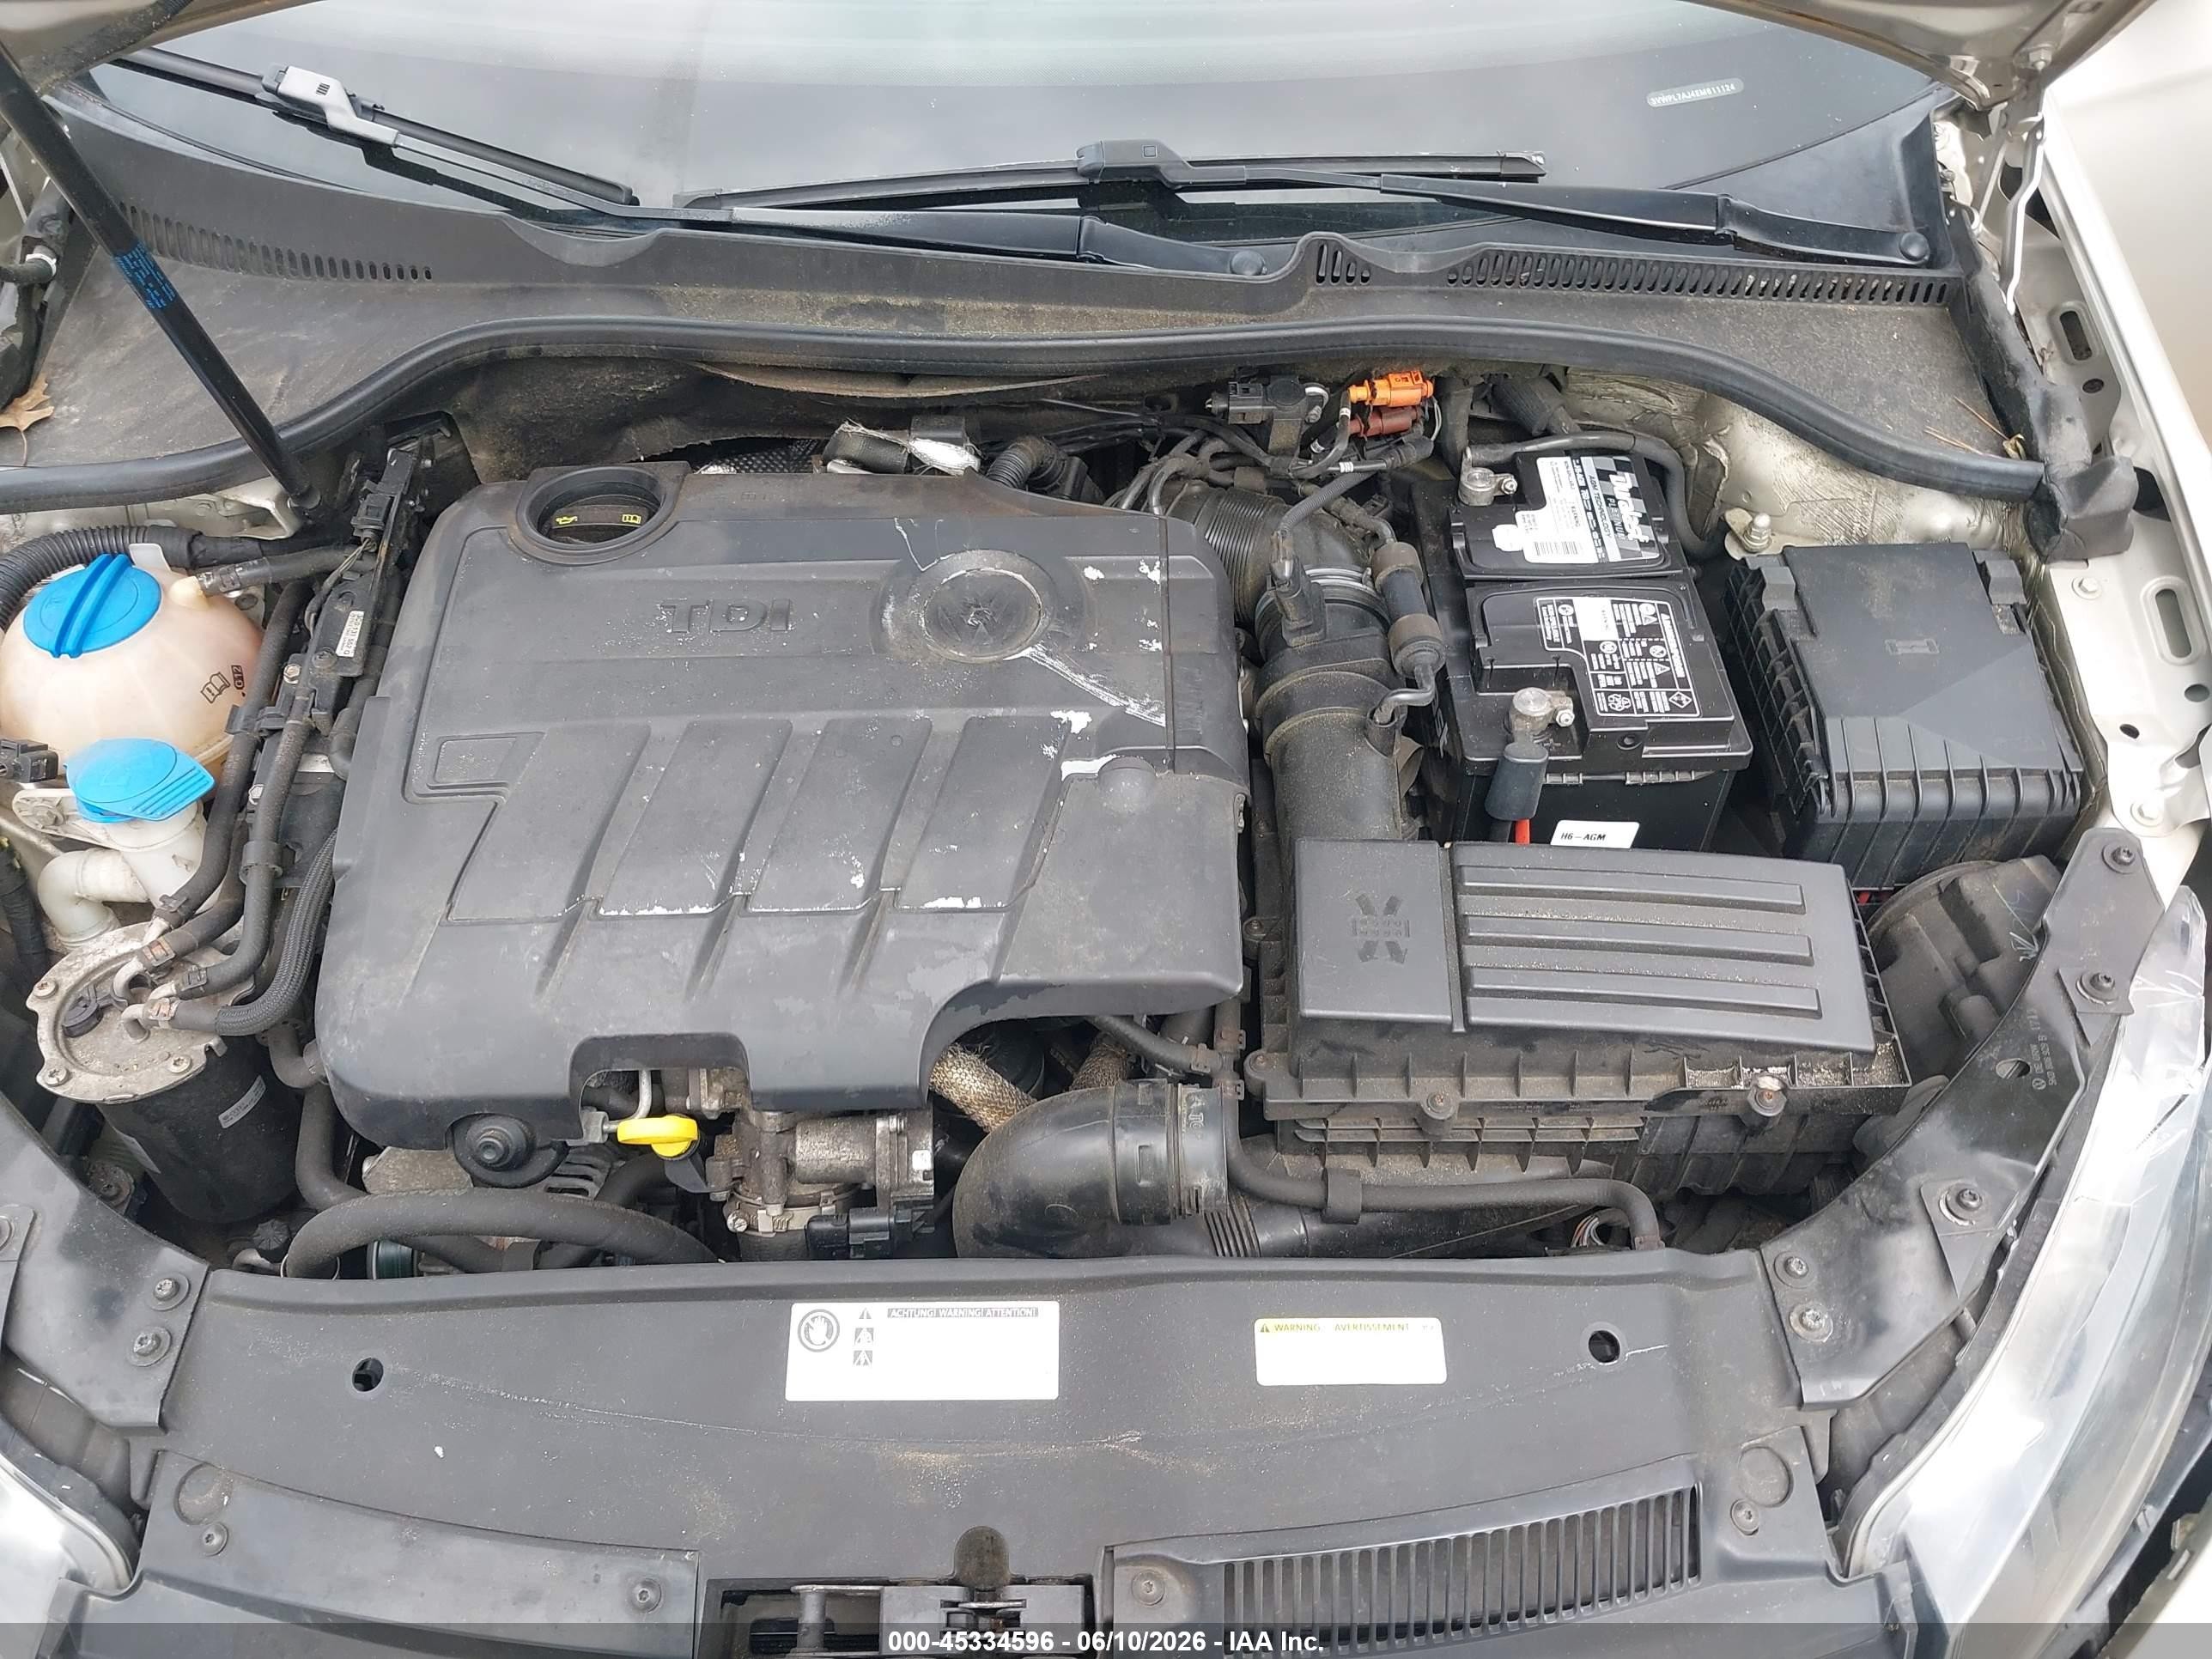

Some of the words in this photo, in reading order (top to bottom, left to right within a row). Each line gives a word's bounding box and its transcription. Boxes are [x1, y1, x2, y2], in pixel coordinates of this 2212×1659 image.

[1594, 493, 1611, 538] TECHNOLOGY
[659, 599, 791, 633] TDI
[233, 666, 243, 687] G12
[890, 1308, 936, 1318] ACHTUNG!
[939, 1308, 983, 1318] WARNING!
[985, 1308, 1036, 1318] ATTENTION!
[1274, 1323, 1320, 1332] WARNING
